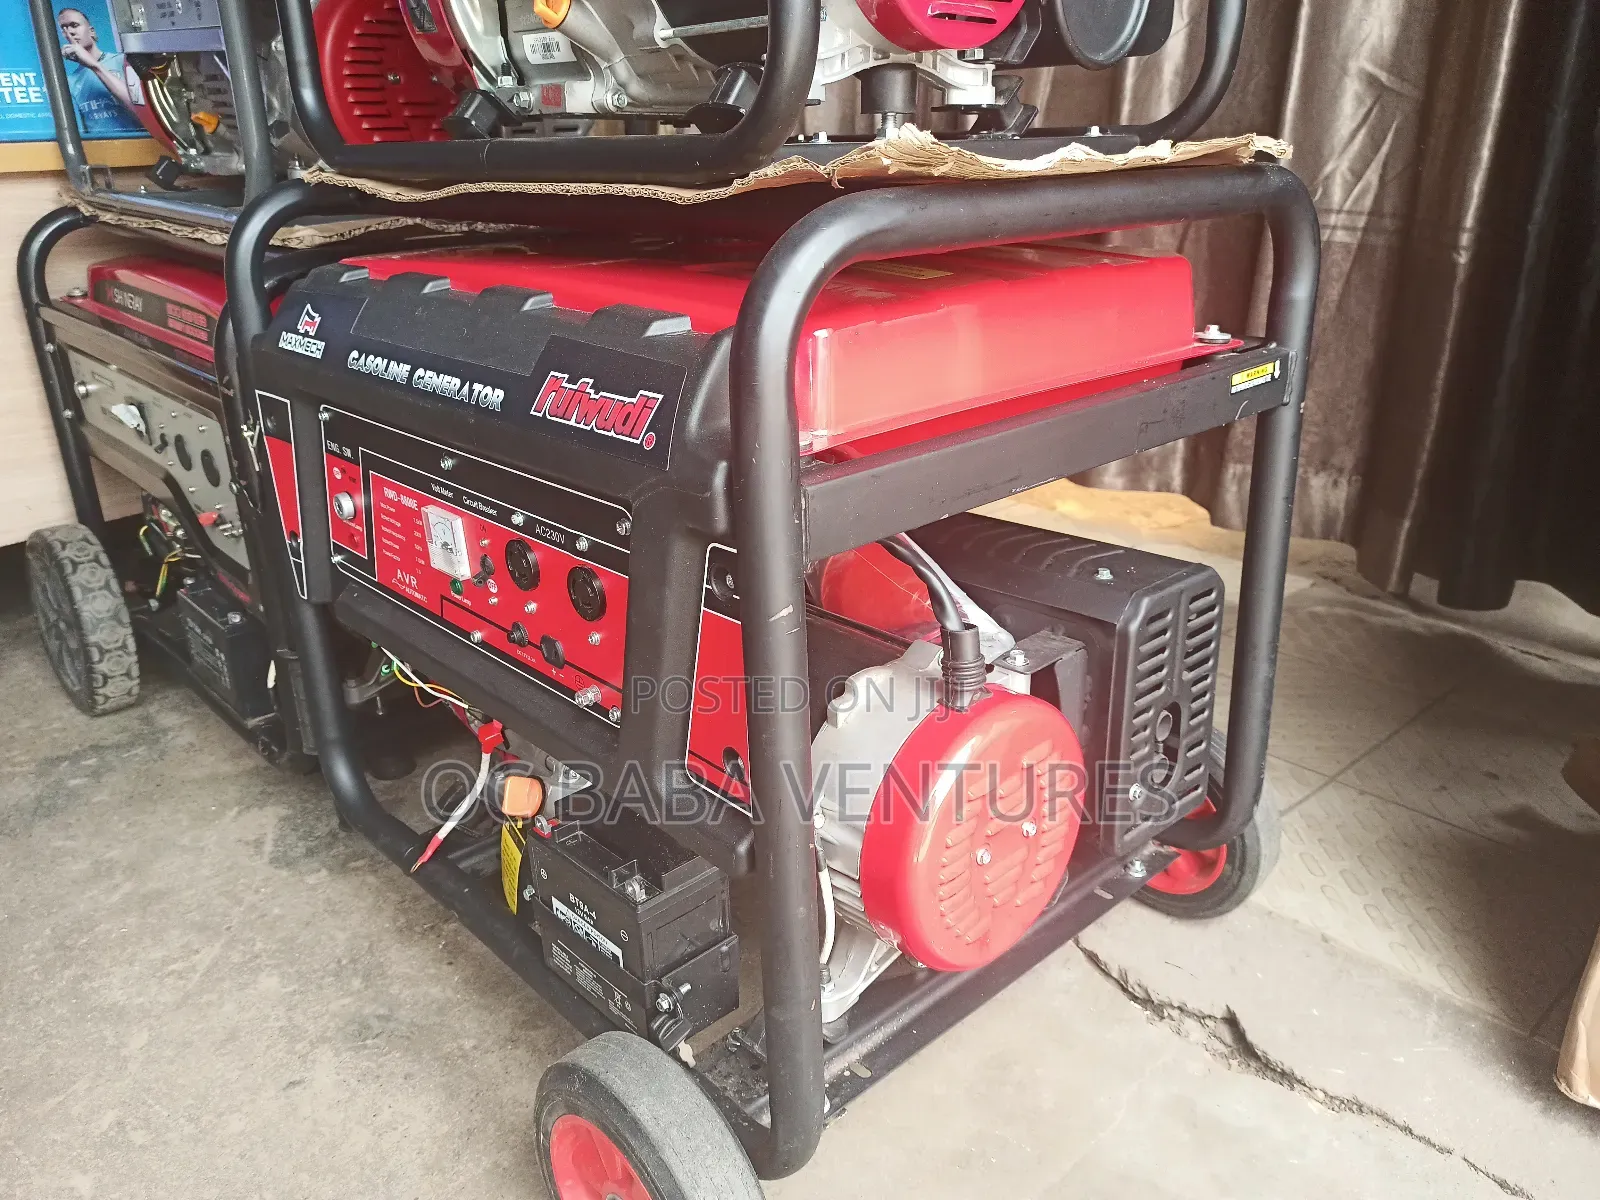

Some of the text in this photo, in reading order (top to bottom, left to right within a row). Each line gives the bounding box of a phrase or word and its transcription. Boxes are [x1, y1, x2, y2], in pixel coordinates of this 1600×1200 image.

[278, 331, 326, 360] MAXMECH
[347, 350, 505, 411] GASOLINE GENERATOR
[326, 440, 342, 455] ENG.
[535, 523, 566, 544] AC230V
[397, 568, 419, 590] AVR
